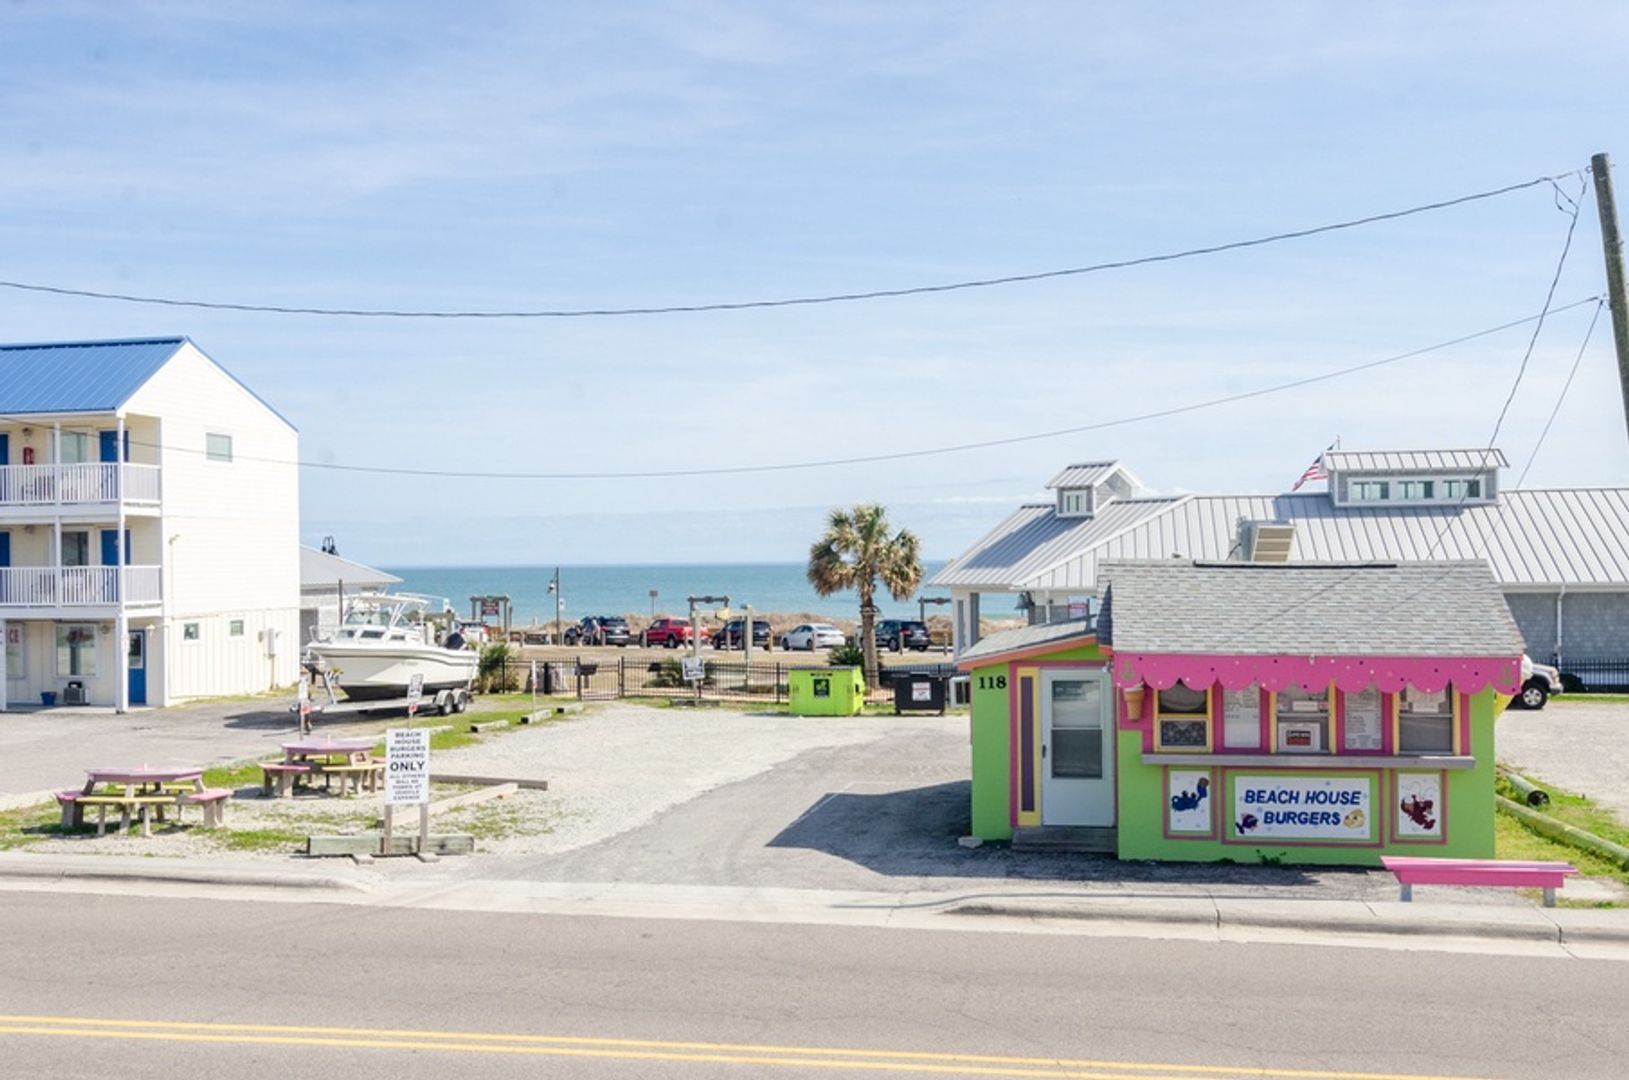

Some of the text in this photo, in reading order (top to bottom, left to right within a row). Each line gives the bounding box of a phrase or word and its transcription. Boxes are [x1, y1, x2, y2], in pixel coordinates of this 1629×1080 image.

[979, 675, 1007, 689] 118
[390, 761, 425, 771] ONLY
[1244, 789, 1362, 805] BEACH HOUSE
[1263, 811, 1342, 825] BURGERS
